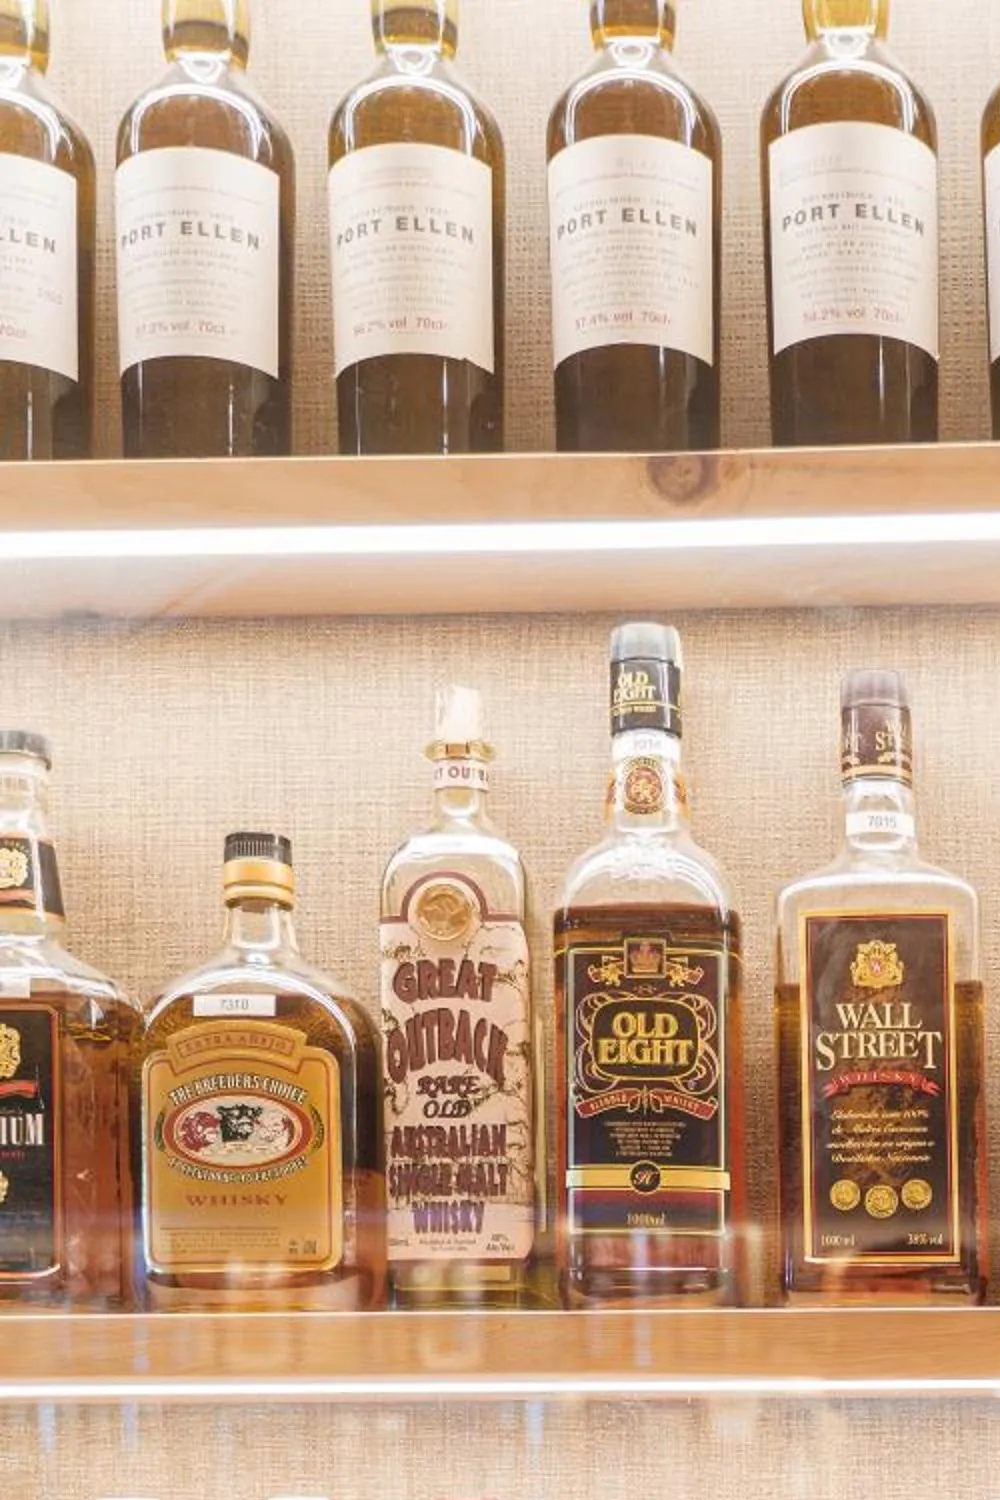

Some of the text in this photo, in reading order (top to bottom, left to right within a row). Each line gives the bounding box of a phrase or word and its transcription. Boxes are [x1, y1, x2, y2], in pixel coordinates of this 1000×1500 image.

[120, 220, 260, 251] PORT ELLEN
[336, 215, 475, 248] PORT ELLEN
[556, 206, 698, 241] PORT ELLEN
[781, 202, 925, 236] PORT ELLEN
[393, 958, 497, 1004] GREAT
[611, 1012, 679, 1040] OLD
[836, 1002, 923, 1031] WALL
[386, 1007, 509, 1093] OUTBACK
[599, 1038, 693, 1067] EIGHT
[816, 1030, 943, 1072] STREET
[415, 1074, 481, 1098] RARE
[423, 1099, 474, 1119] OLD
[390, 1123, 507, 1159] AUSTRALIAN
[389, 1163, 508, 1198] SINGLE MALT
[187, 1193, 289, 1208] WHISKY
[412, 1200, 485, 1234] WHISKY
